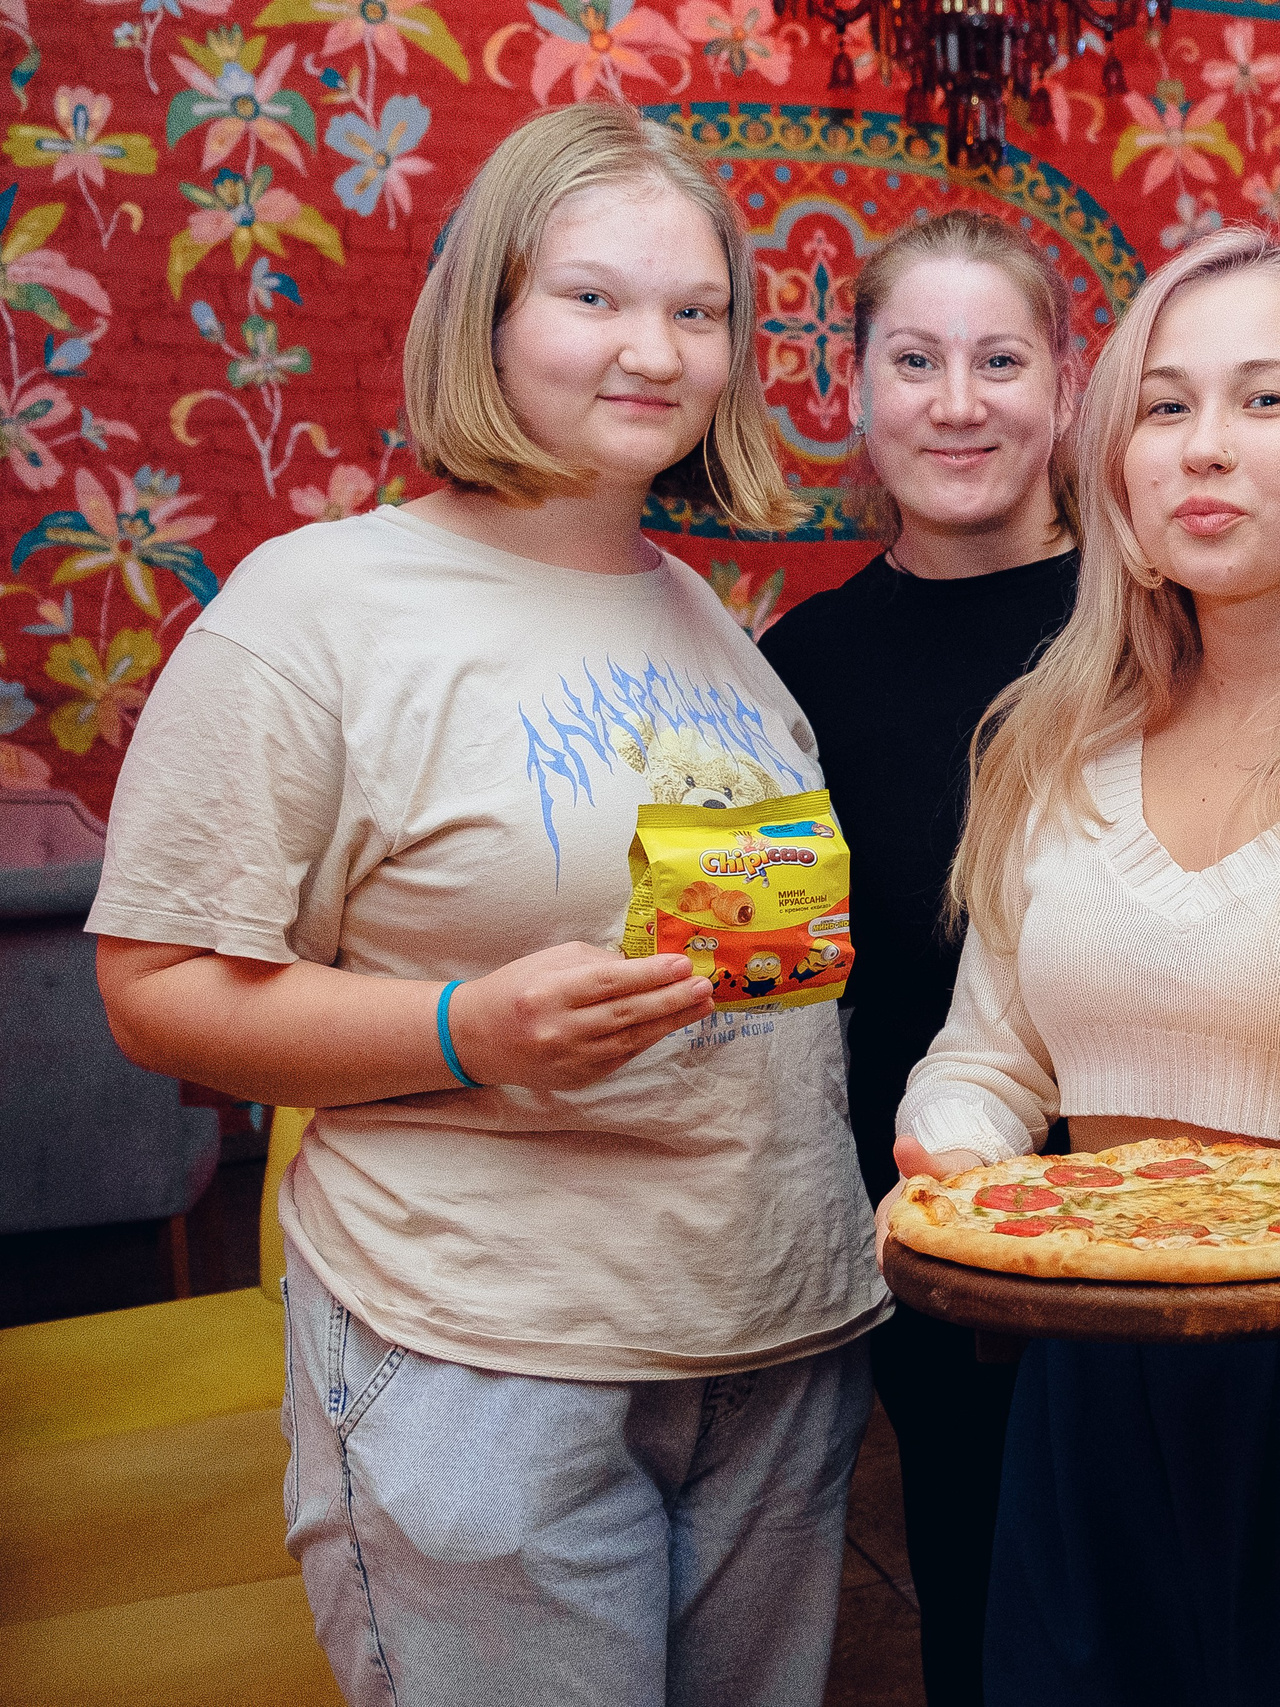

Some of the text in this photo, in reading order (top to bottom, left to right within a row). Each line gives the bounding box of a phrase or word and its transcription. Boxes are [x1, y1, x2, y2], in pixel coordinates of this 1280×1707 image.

[701, 847, 816, 877] Chipicao
[778, 888, 806, 899] МИНИ
[778, 894, 828, 907] КРУАССАНЫ
[687, 1029, 735, 1050] TRYING
